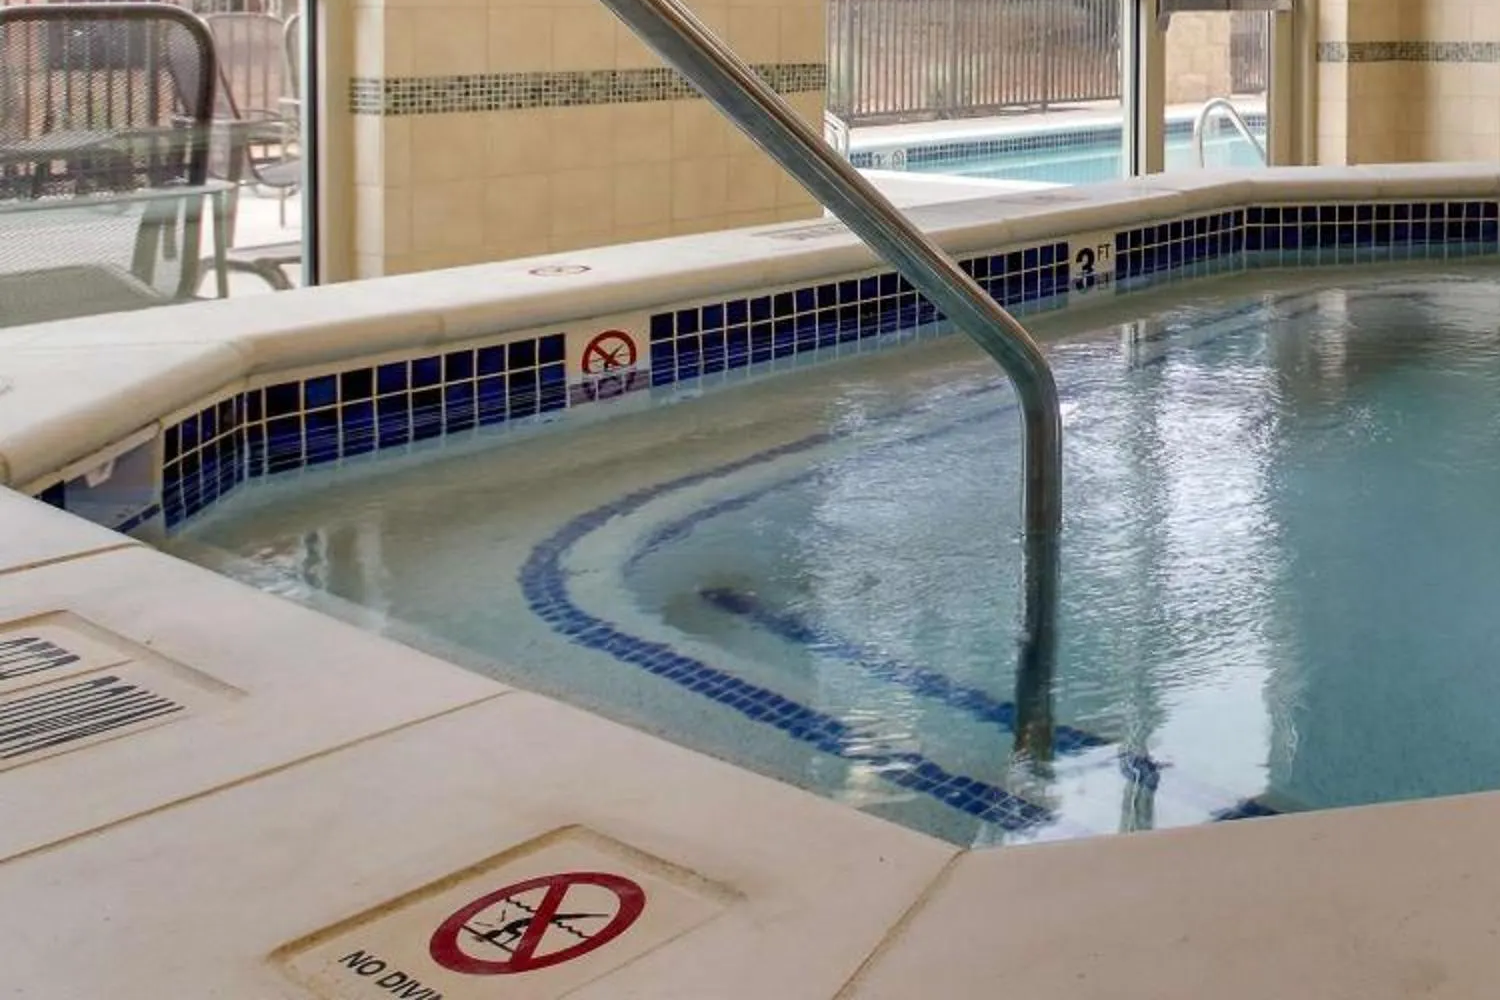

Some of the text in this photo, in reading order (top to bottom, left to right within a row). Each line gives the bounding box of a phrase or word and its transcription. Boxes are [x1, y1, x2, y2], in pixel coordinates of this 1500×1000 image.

[1097, 244, 1111, 261] FT
[338, 950, 443, 1000] NO DIVI
